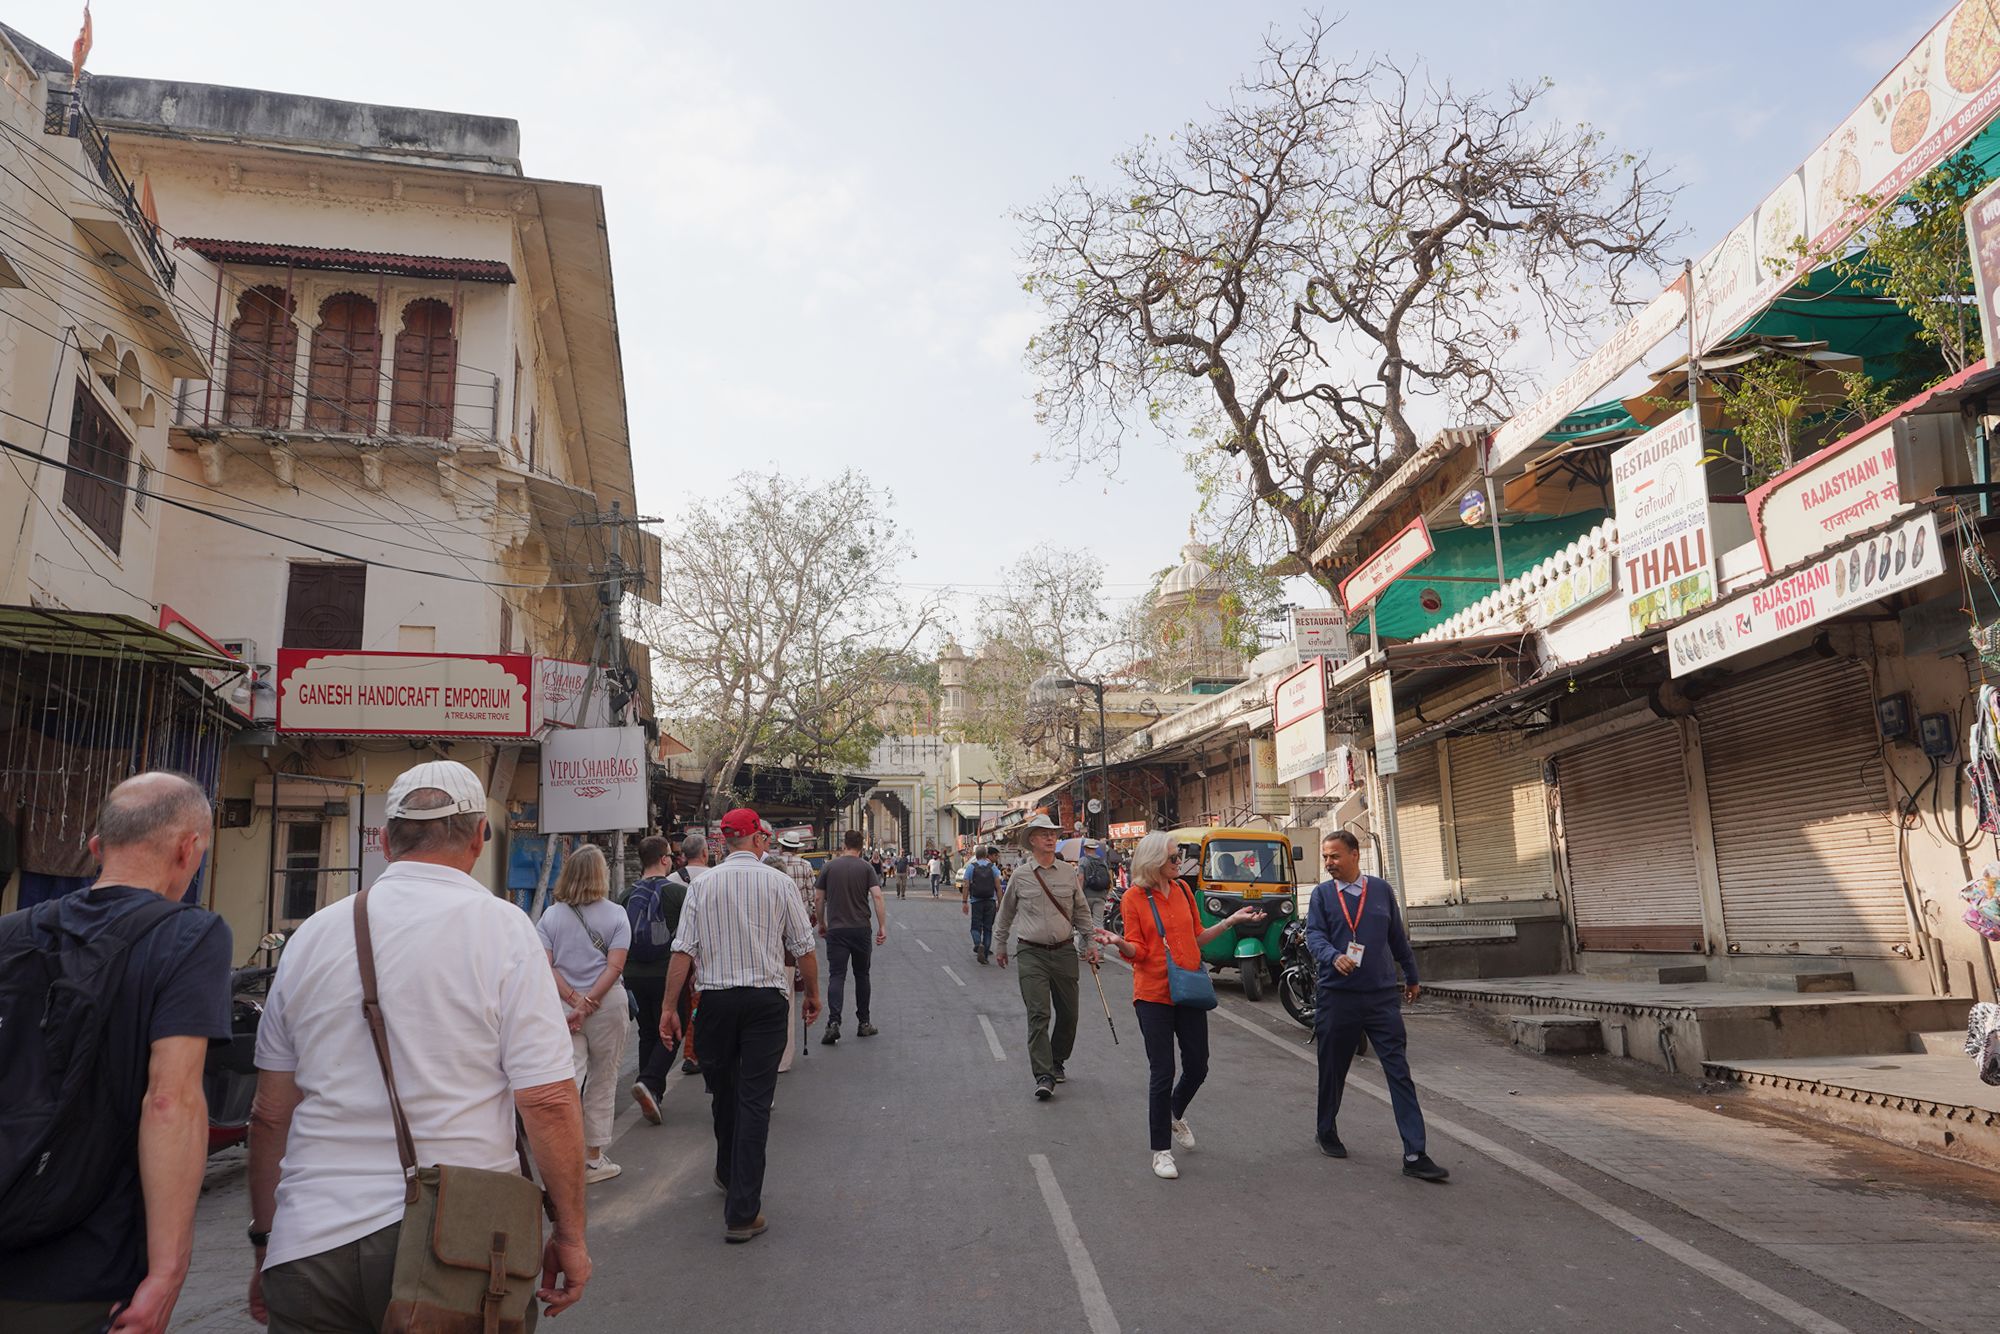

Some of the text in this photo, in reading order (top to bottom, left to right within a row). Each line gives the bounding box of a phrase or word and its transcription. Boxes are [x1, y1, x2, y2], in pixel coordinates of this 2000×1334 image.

[1555, 365, 1590, 398] SILVER
[1593, 320, 1640, 369] JEWELS
[1615, 422, 1696, 484] RESTAURANT
[1801, 456, 1879, 511] RAJASTHANI
[1687, 497, 1704, 511] FOOD
[1820, 490, 1880, 532] राजस्थानी
[1625, 528, 1707, 595] THALI
[1752, 563, 1830, 616] RAJASTHANI
[1296, 617, 1343, 626] RESTAURANT
[1774, 597, 1816, 631] MOJDI
[299, 684, 510, 708] GANESH HANDICRAFT EMPORIUM
[444, 711, 450, 720] A
[451, 712, 486, 720] TREASURE
[578, 778, 605, 786] ECLECTIC
[606, 777, 638, 785] ECCENTRIC
